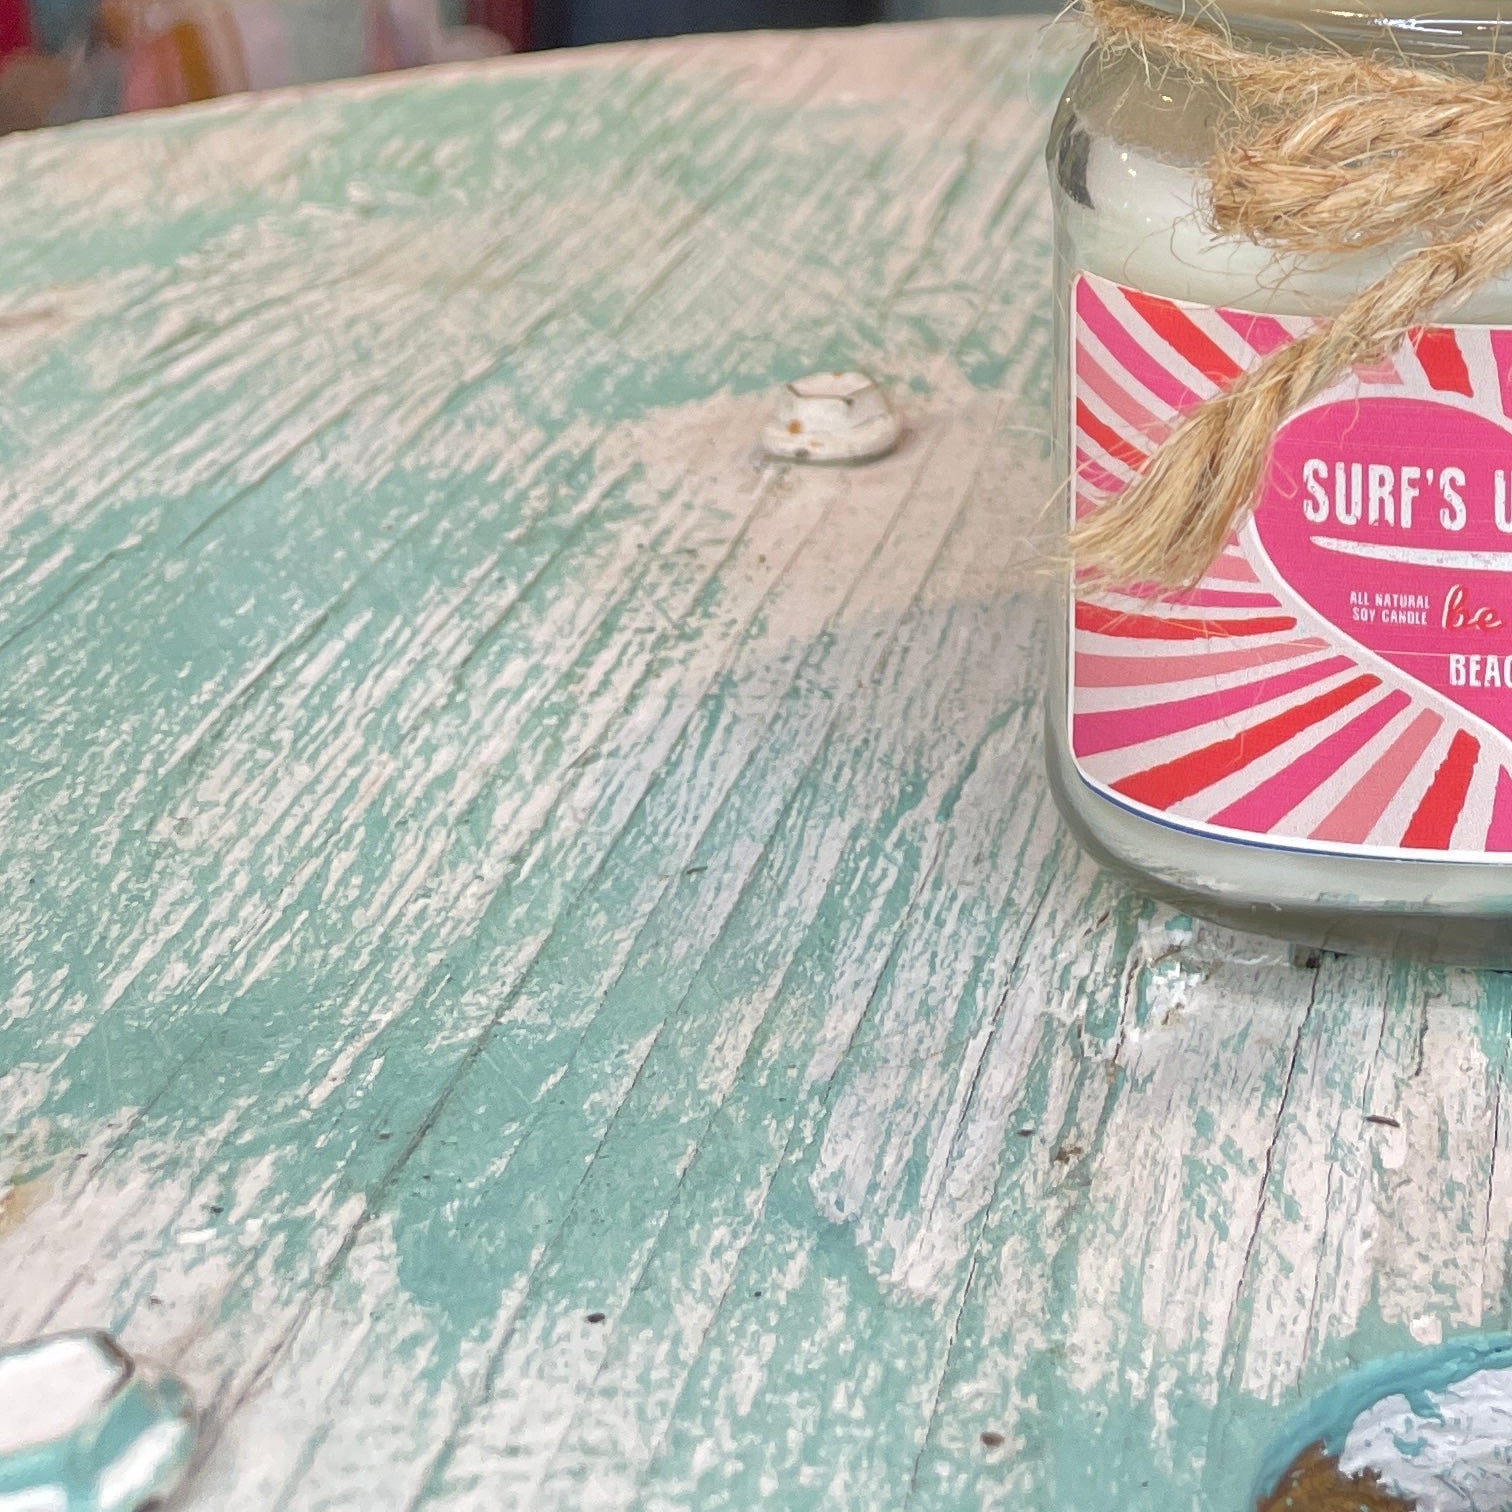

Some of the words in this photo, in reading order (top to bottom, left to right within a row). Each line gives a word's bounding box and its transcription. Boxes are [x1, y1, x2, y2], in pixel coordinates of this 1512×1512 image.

[1303, 458, 1467, 531] SURF'S
[1350, 591, 1369, 605] ALL
[1375, 593, 1430, 609] NATURAL
[1352, 607, 1376, 622] SOY
[1381, 609, 1428, 625] CANDLE
[1442, 584, 1502, 630] be
